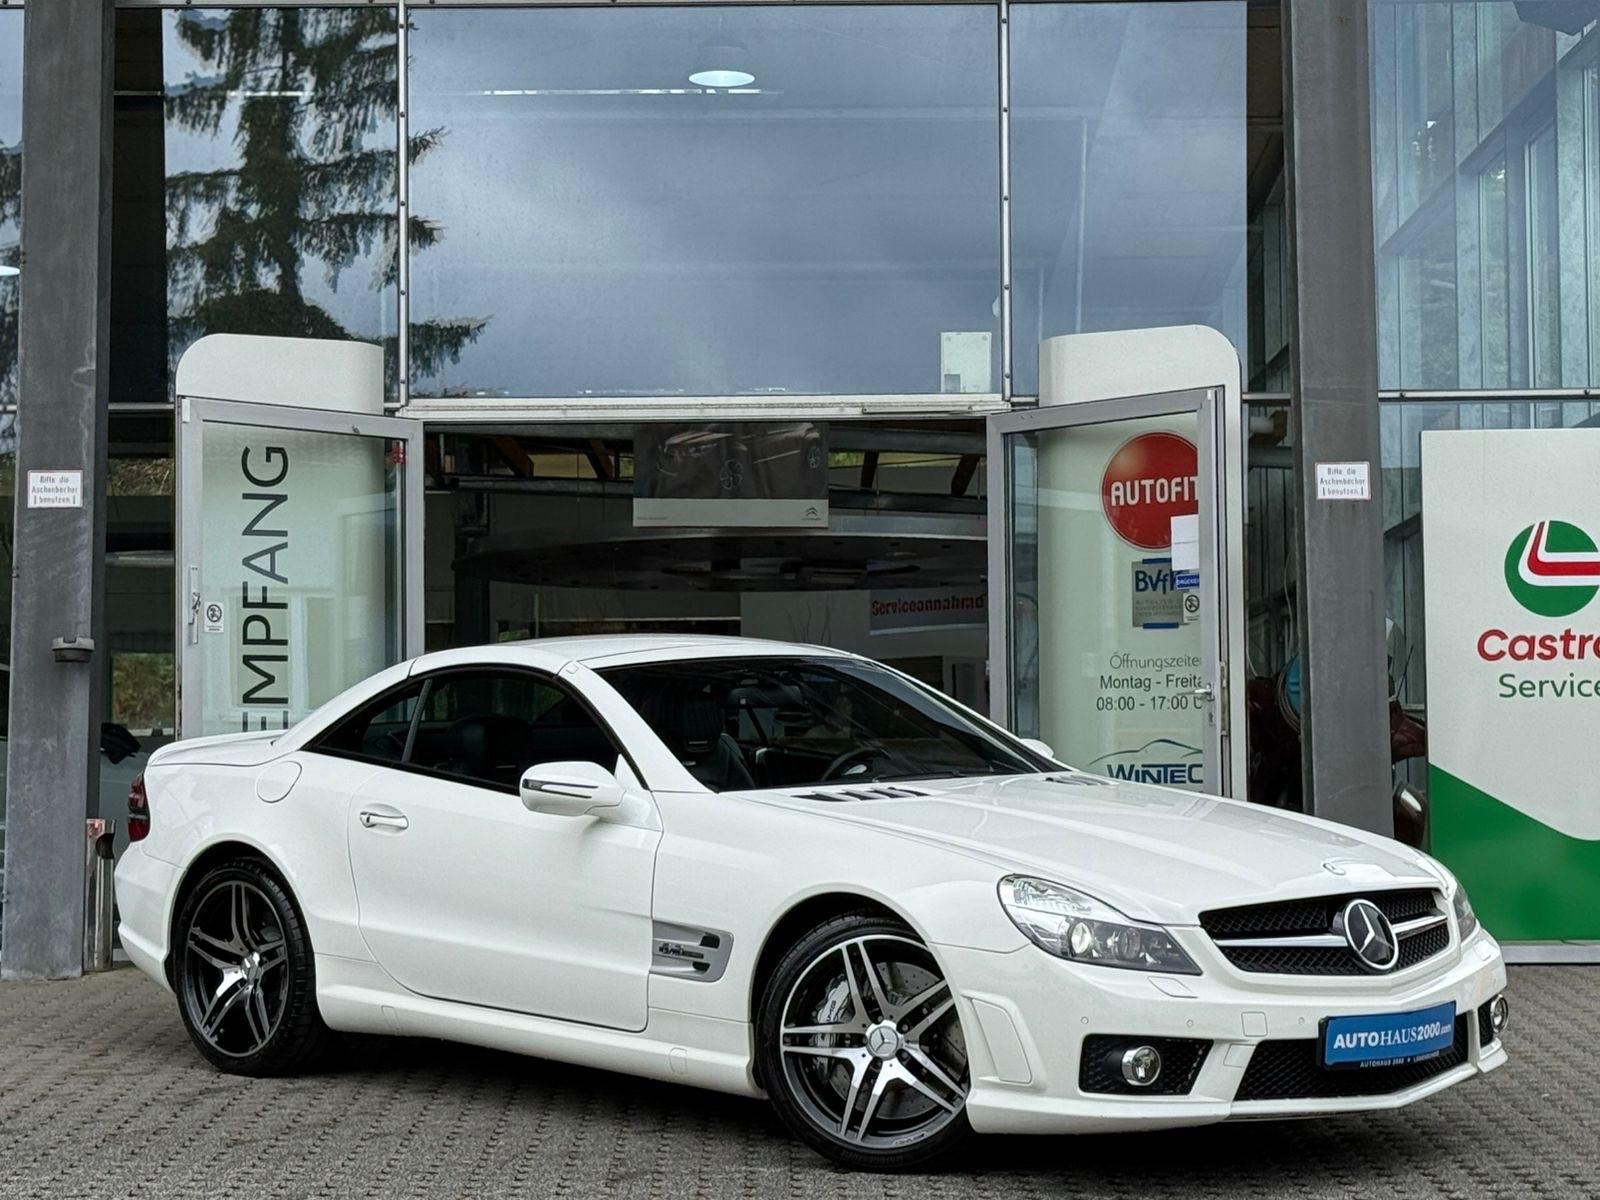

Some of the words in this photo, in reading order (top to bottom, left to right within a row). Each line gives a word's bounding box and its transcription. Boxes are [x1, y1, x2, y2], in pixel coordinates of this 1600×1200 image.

[241, 446, 289, 732] EMPFANG
[1477, 628, 1600, 661] Castr
[1110, 652, 1201, 672] Öffnungszeite
[1100, 675, 1151, 692] Montag
[1097, 697, 1135, 711] 08:00
[1151, 696, 1188, 710] 17:00
